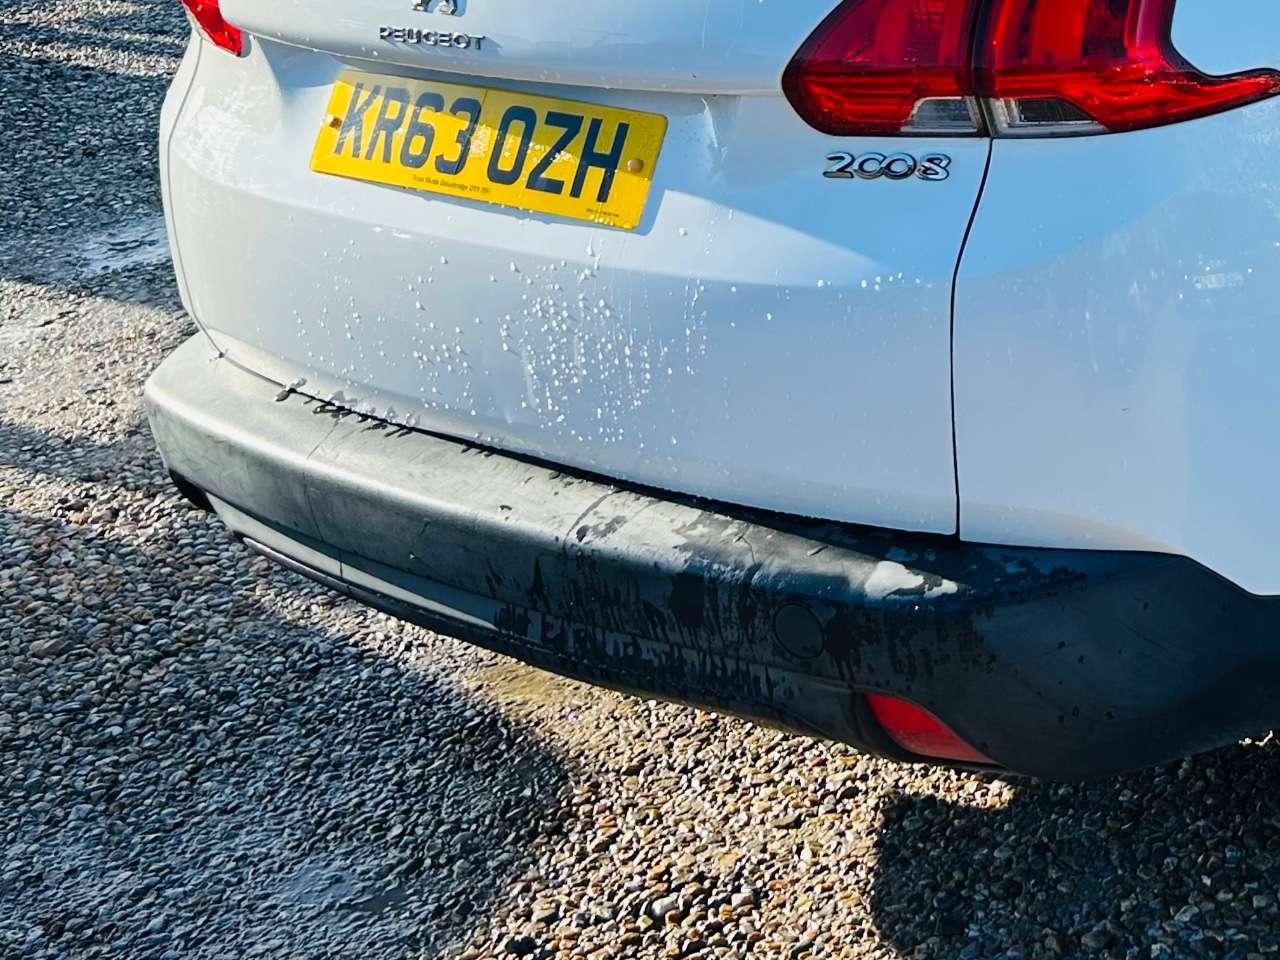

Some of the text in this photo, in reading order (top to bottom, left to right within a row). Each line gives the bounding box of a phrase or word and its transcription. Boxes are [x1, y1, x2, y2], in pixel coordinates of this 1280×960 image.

[379, 25, 487, 50] PEUGEOT
[333, 82, 631, 204] KR63 OZH
[822, 150, 952, 181] 2008
